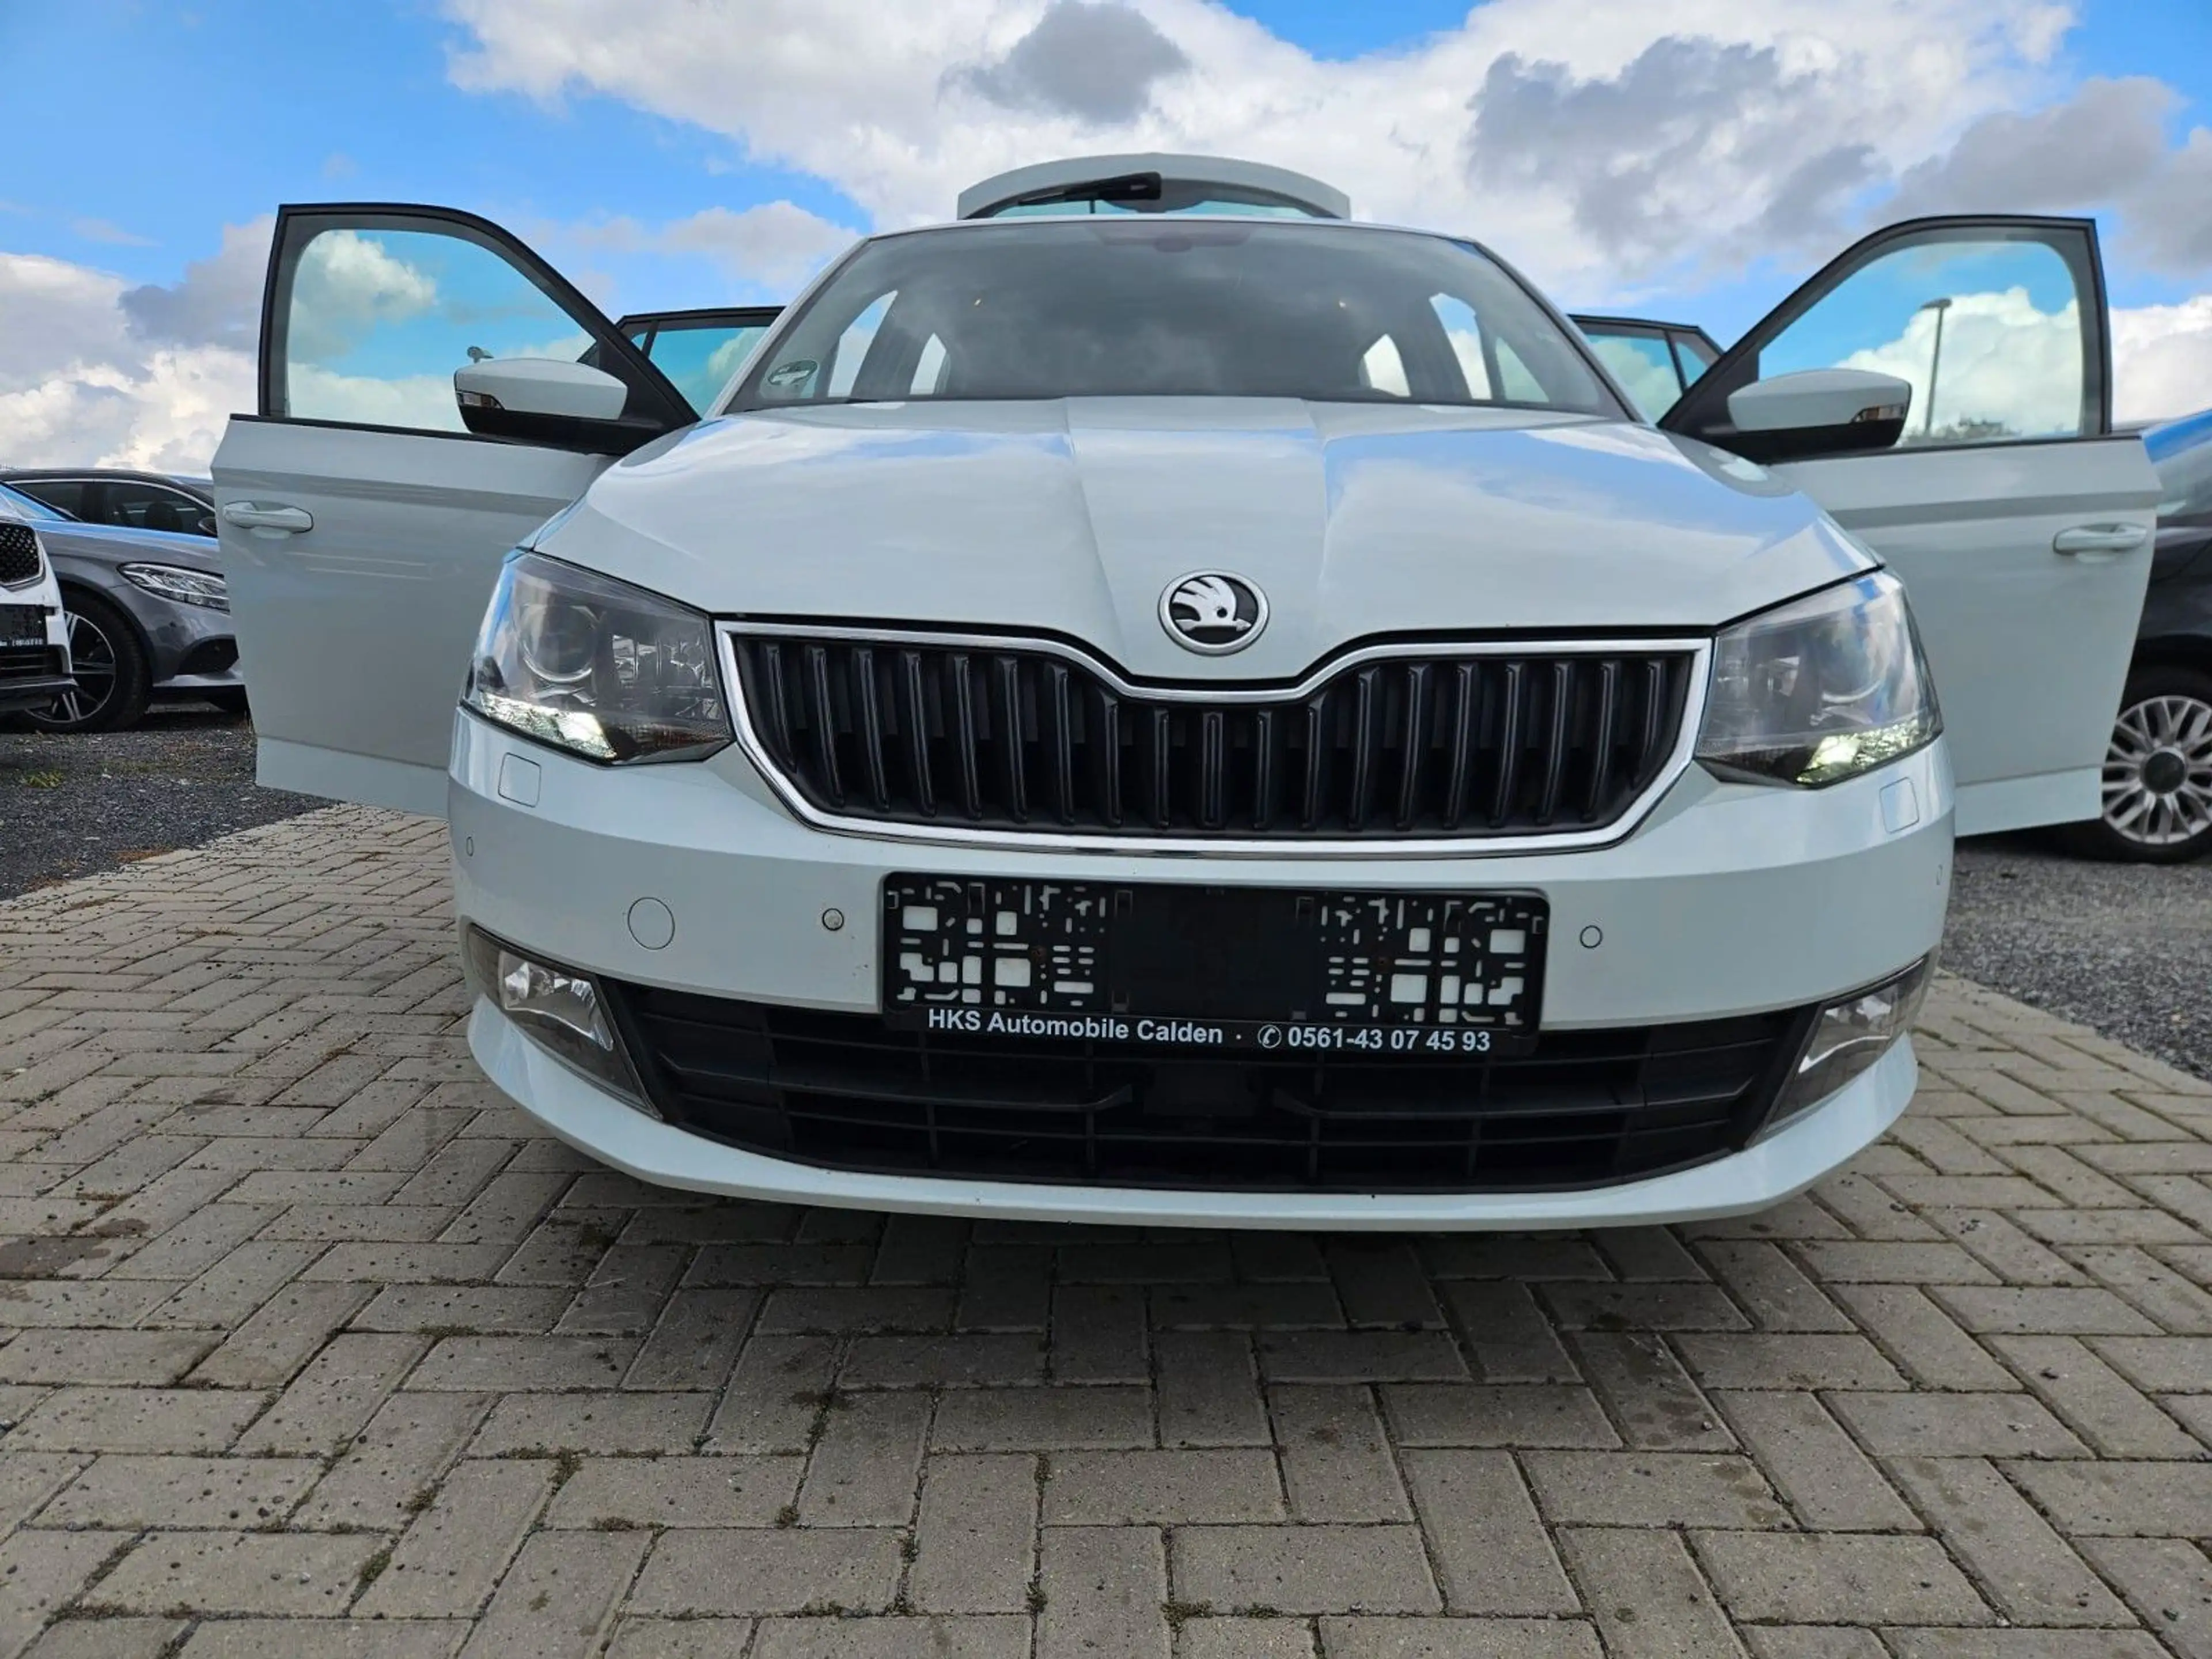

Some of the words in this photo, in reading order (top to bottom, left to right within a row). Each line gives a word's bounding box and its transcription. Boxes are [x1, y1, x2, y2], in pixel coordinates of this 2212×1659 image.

[929, 1009, 980, 1031] HKS
[987, 1012, 1129, 1039] Automobile
[1137, 1020, 1222, 1043] Calden
[1288, 1027, 1382, 1048] 0561-43
[1391, 1030, 1419, 1050] 07
[1426, 1031, 1455, 1050] 45
[1463, 1031, 1490, 1051] 93
